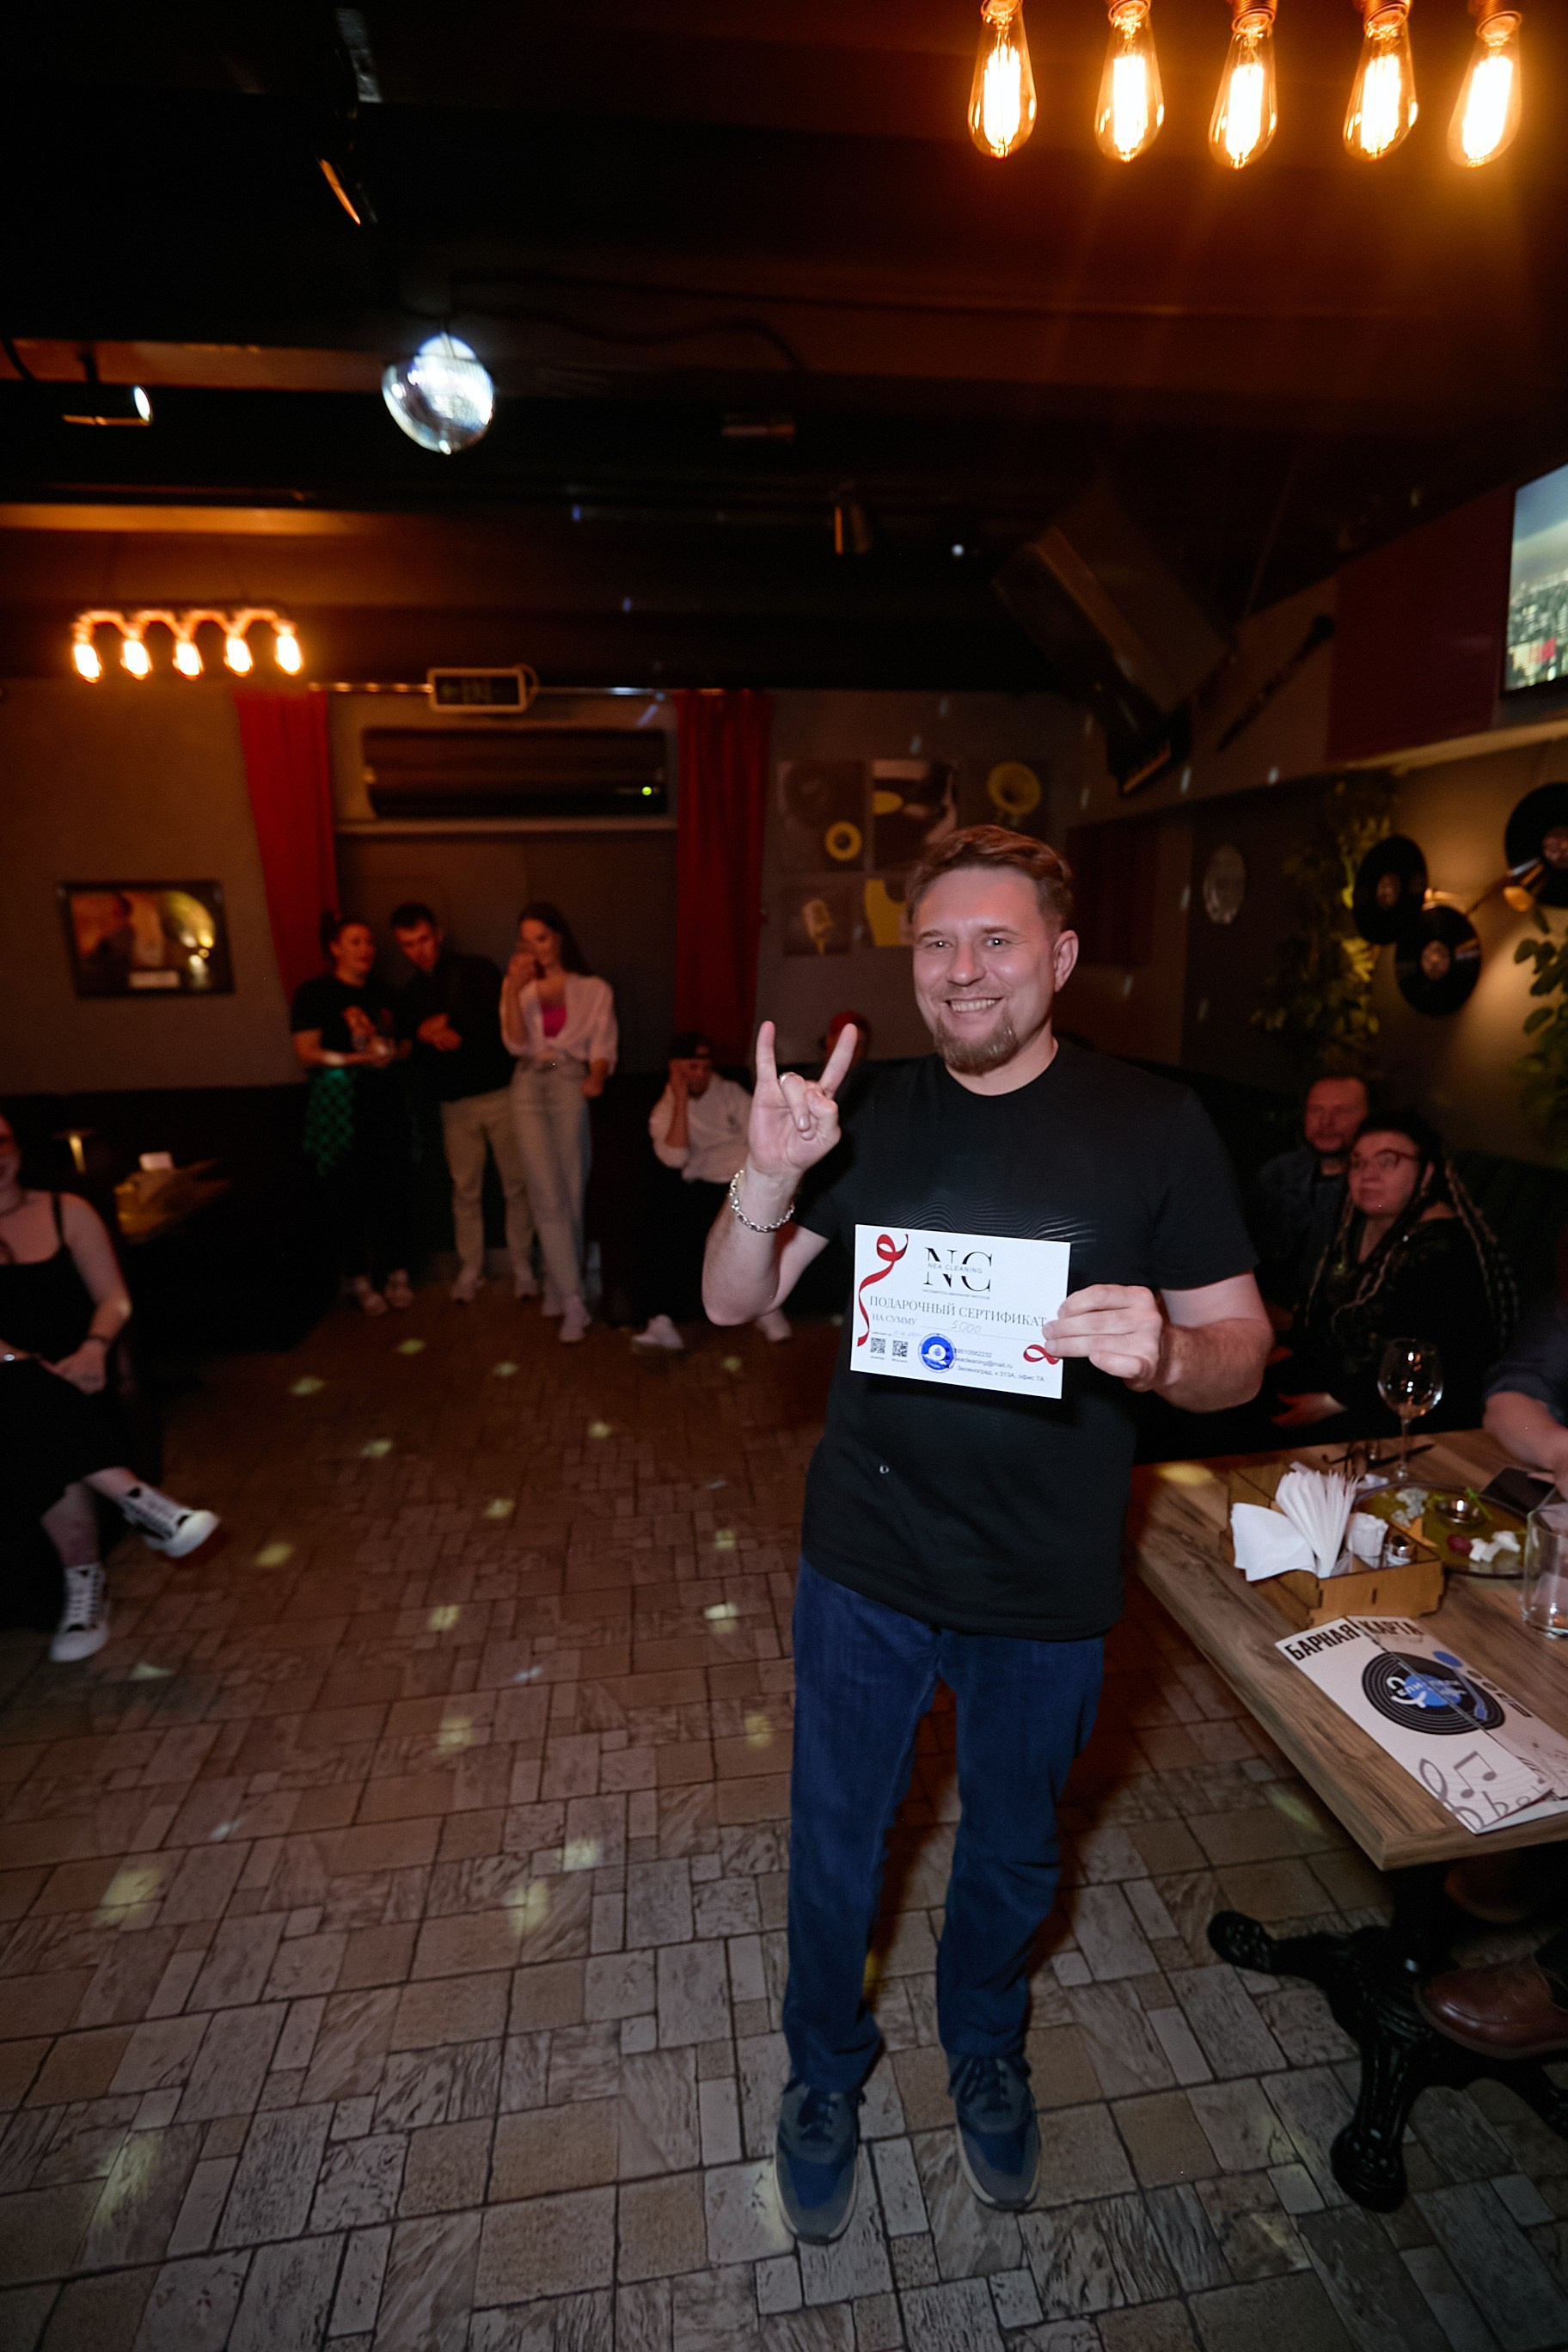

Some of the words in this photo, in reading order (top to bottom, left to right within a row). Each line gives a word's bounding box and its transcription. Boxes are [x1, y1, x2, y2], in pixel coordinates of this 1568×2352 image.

[928, 1262, 942, 1271] NEA
[945, 1265, 983, 1274] CLEANING
[869, 1295, 957, 1316] ПОДАРОЧНЫЙ
[959, 1307, 1048, 1328] СЕРТИФИКАТ
[872, 1313, 885, 1322] НА
[886, 1314, 917, 1326] СУММУ
[1284, 1623, 1361, 1661] БАРНАЯ
[1351, 1620, 1424, 1635] КАРТА
